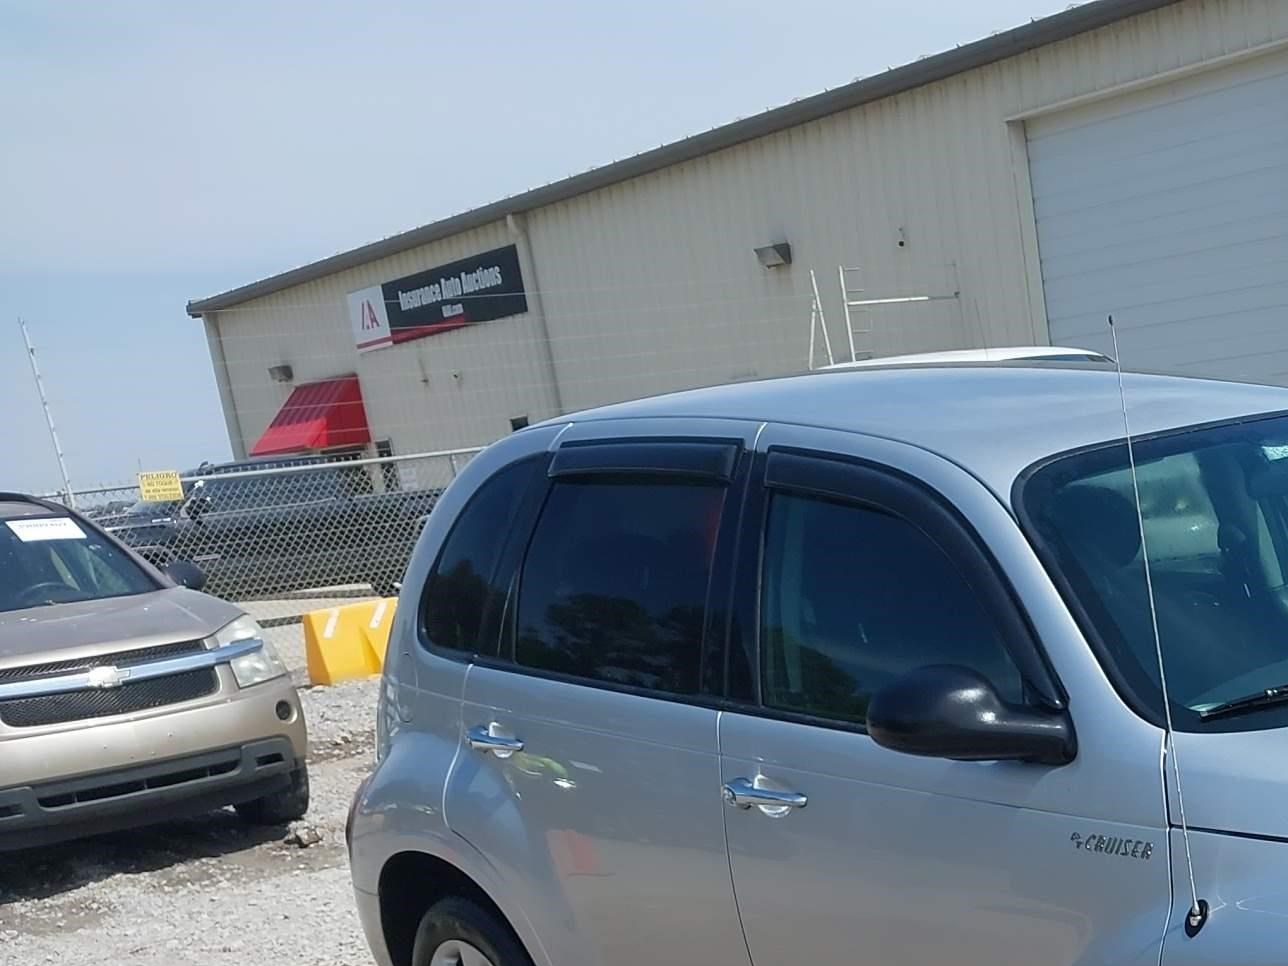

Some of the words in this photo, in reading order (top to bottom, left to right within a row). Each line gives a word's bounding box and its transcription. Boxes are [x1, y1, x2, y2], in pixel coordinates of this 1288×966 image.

[398, 283, 442, 311] Insurance
[440, 278, 462, 299] Auto
[461, 266, 502, 294] Auctions
[1085, 833, 1153, 859] CRUISER
